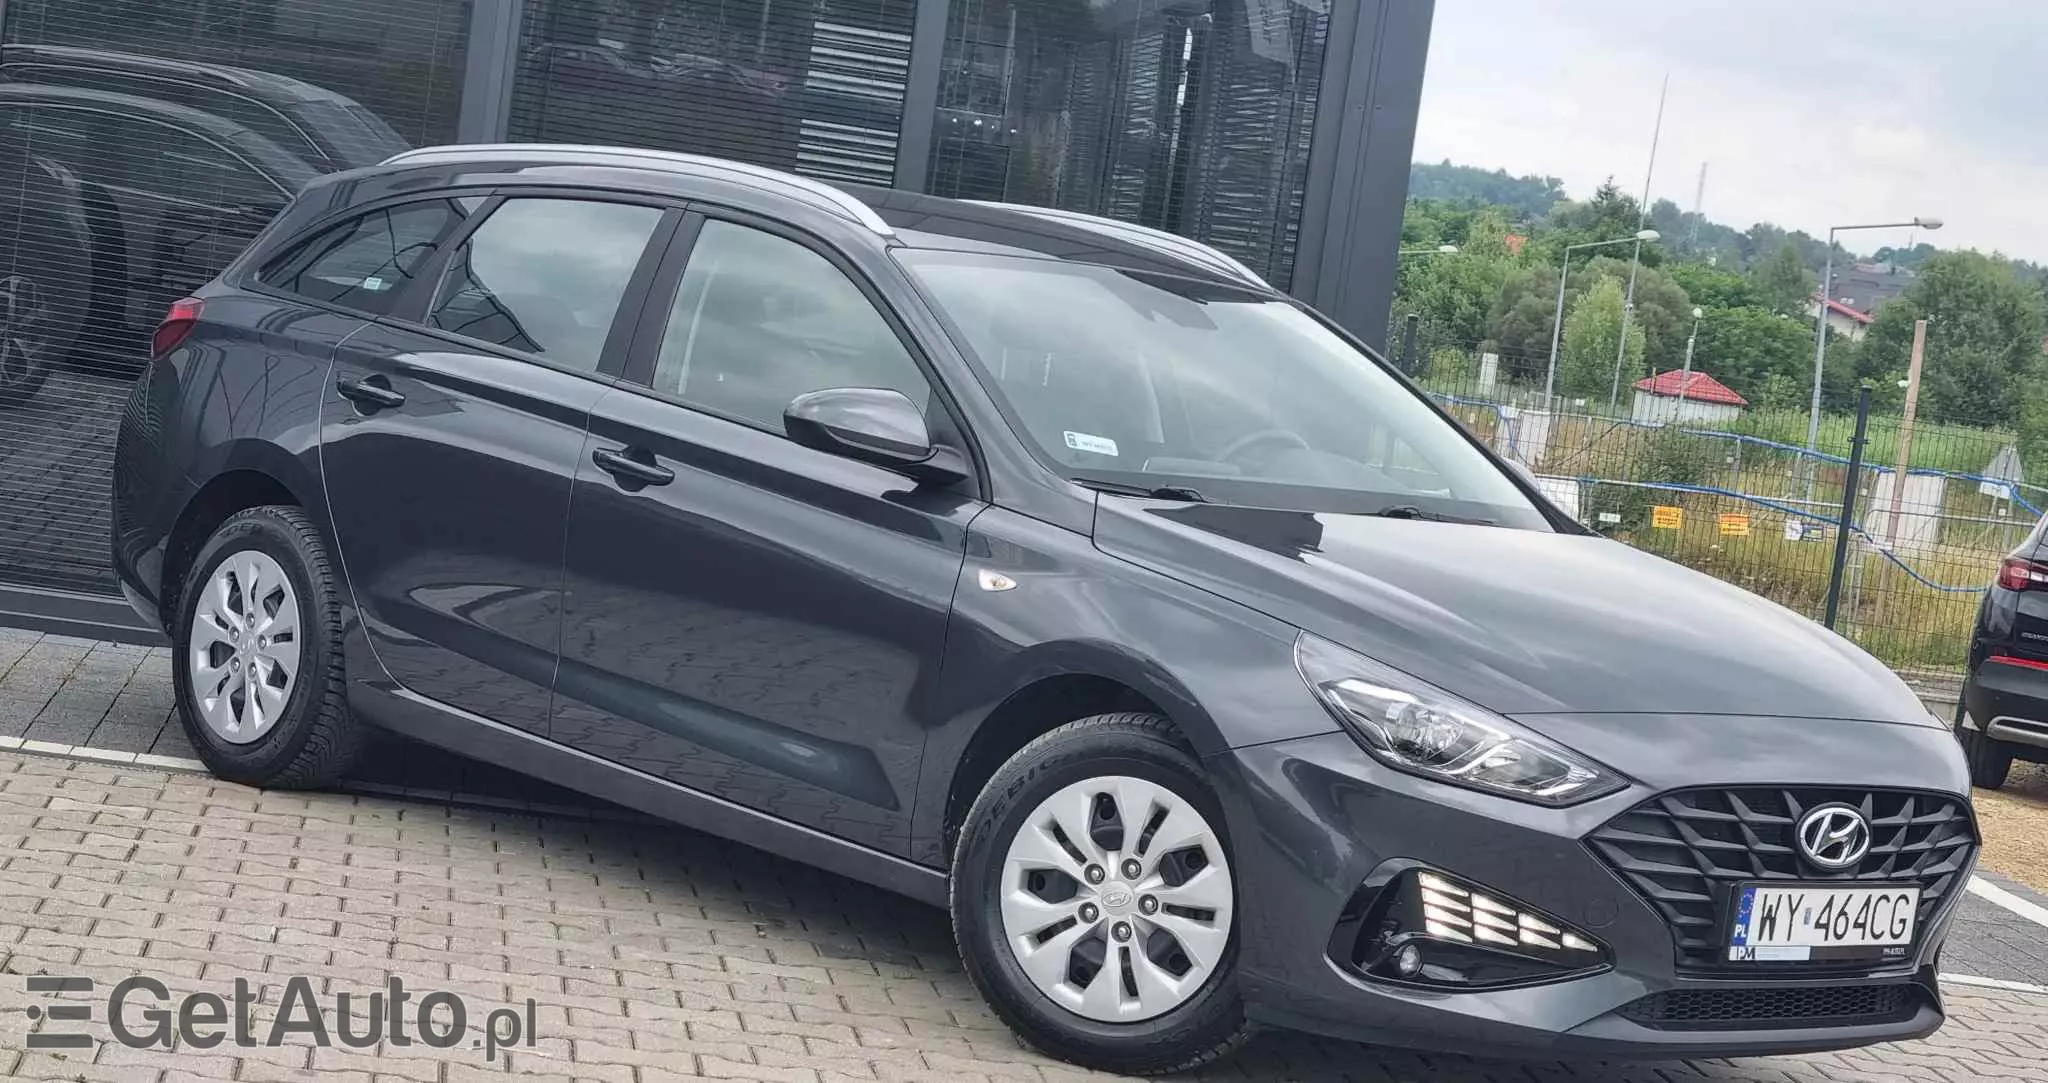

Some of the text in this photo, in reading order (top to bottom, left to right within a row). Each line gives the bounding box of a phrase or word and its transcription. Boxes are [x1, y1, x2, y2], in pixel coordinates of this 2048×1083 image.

[1734, 923, 1747, 938] PL
[1758, 894, 1910, 942] WY 464CG
